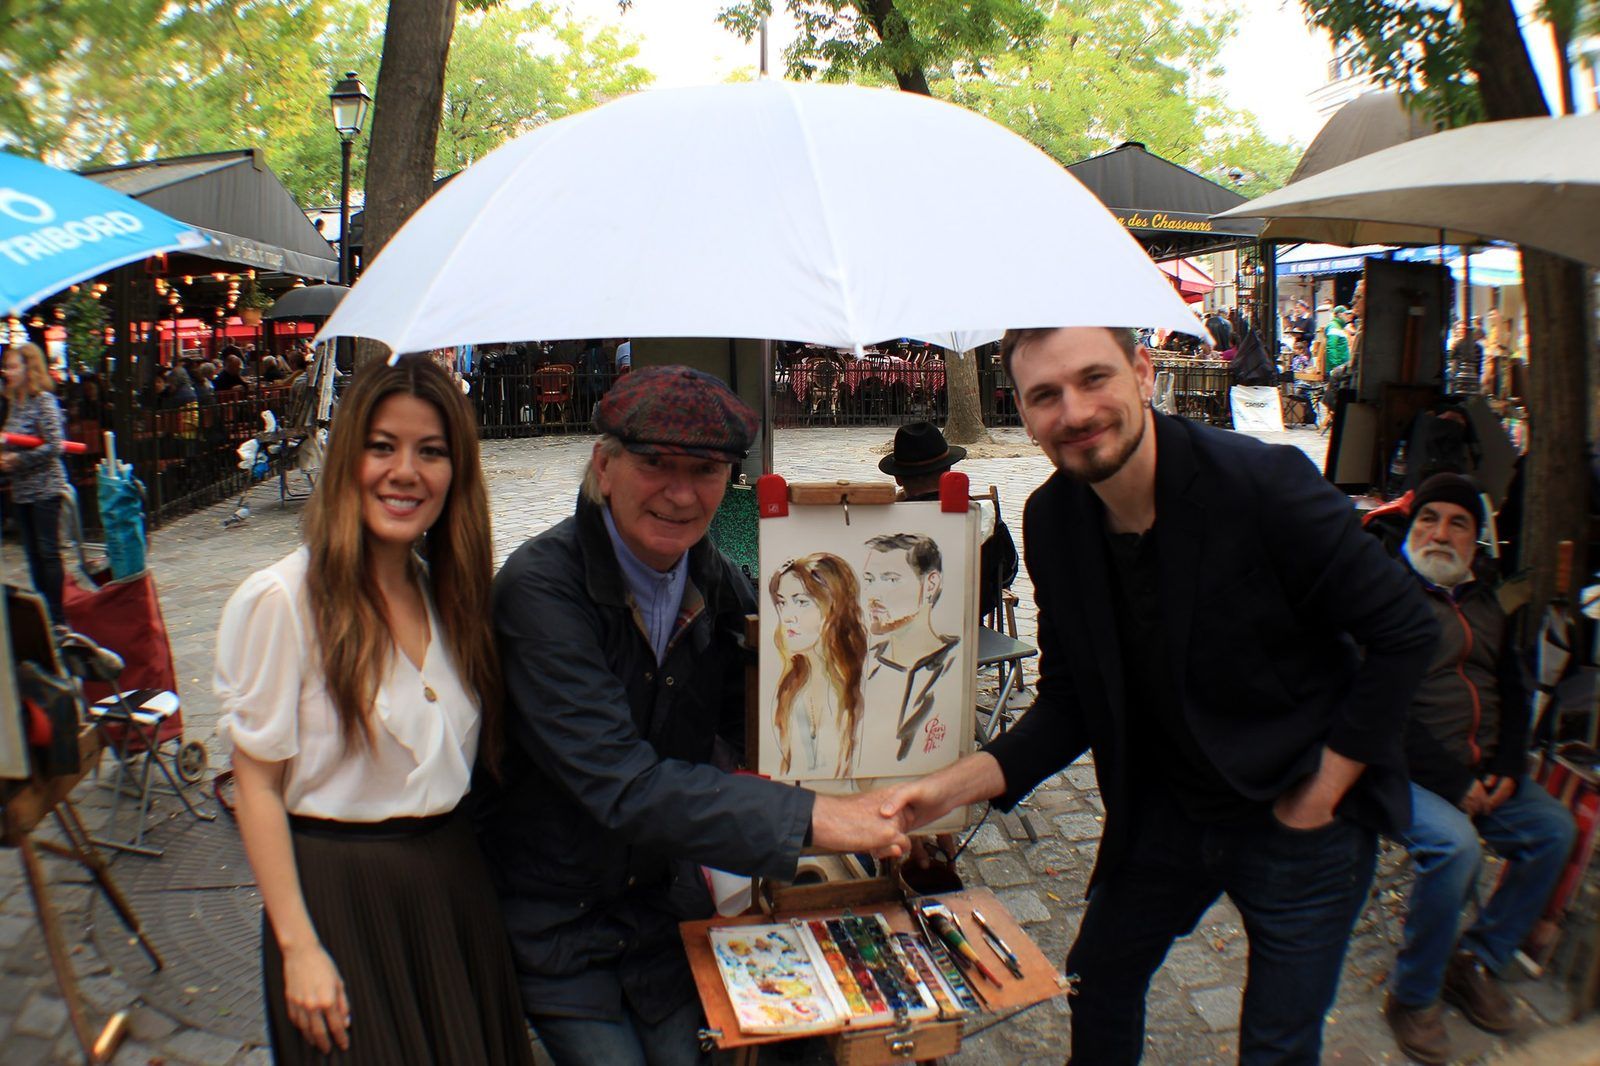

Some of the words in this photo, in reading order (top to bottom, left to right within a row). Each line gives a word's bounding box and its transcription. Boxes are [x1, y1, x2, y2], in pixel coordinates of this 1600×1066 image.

[0, 211, 144, 265] TRIBORD
[1128, 213, 1149, 228] des
[1151, 213, 1213, 231] Chasseurs
